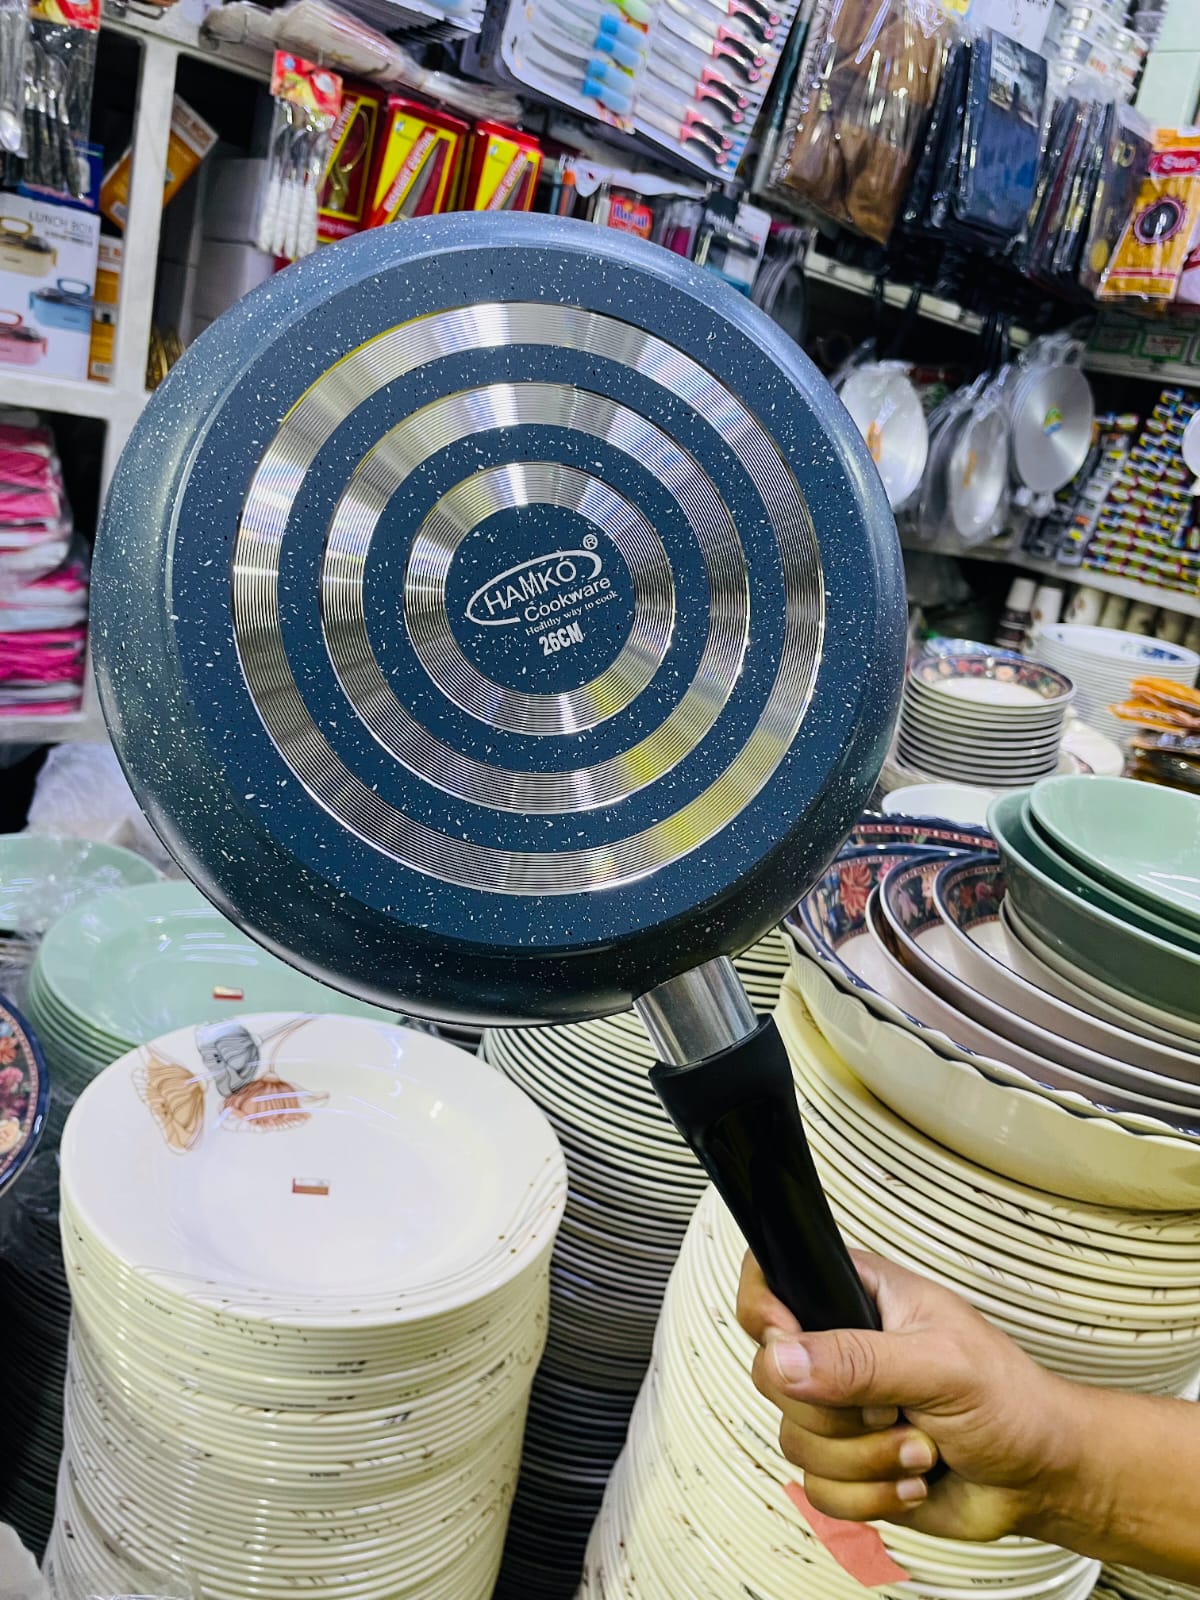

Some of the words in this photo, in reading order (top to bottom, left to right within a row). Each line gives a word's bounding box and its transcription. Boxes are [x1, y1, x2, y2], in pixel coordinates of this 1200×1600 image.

[484, 560, 577, 615] HAMKO
[524, 577, 611, 622] Cookware
[525, 616, 561, 636] Healthy
[563, 607, 582, 618] way
[584, 602, 594, 610] to
[595, 590, 618, 605] cook
[538, 622, 585, 656] 26CM
